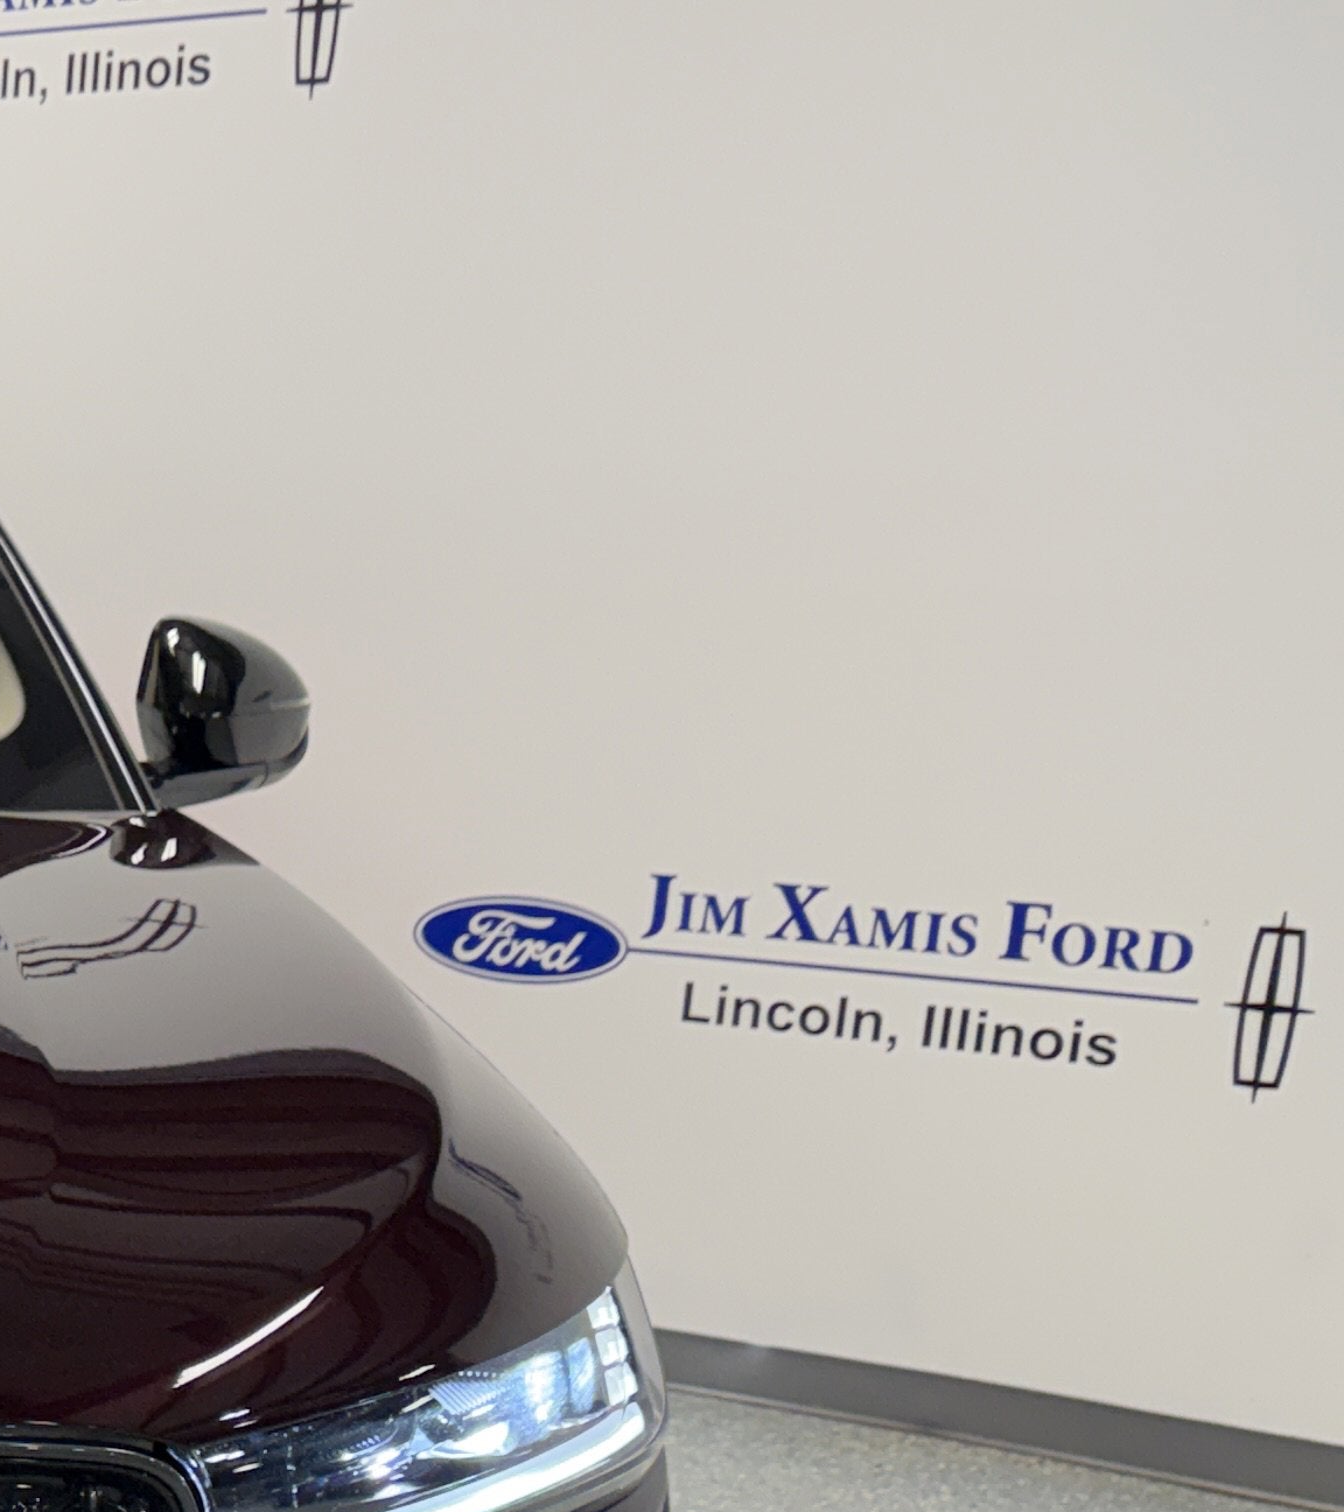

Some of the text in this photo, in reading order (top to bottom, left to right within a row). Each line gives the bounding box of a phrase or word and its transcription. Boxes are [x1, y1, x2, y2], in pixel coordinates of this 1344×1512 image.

[65, 44, 211, 95] Illinois
[452, 907, 581, 974] Ford
[642, 874, 1194, 973] JIM XAMIS FORD
[681, 982, 1117, 1067] Lincoln, Illinois
